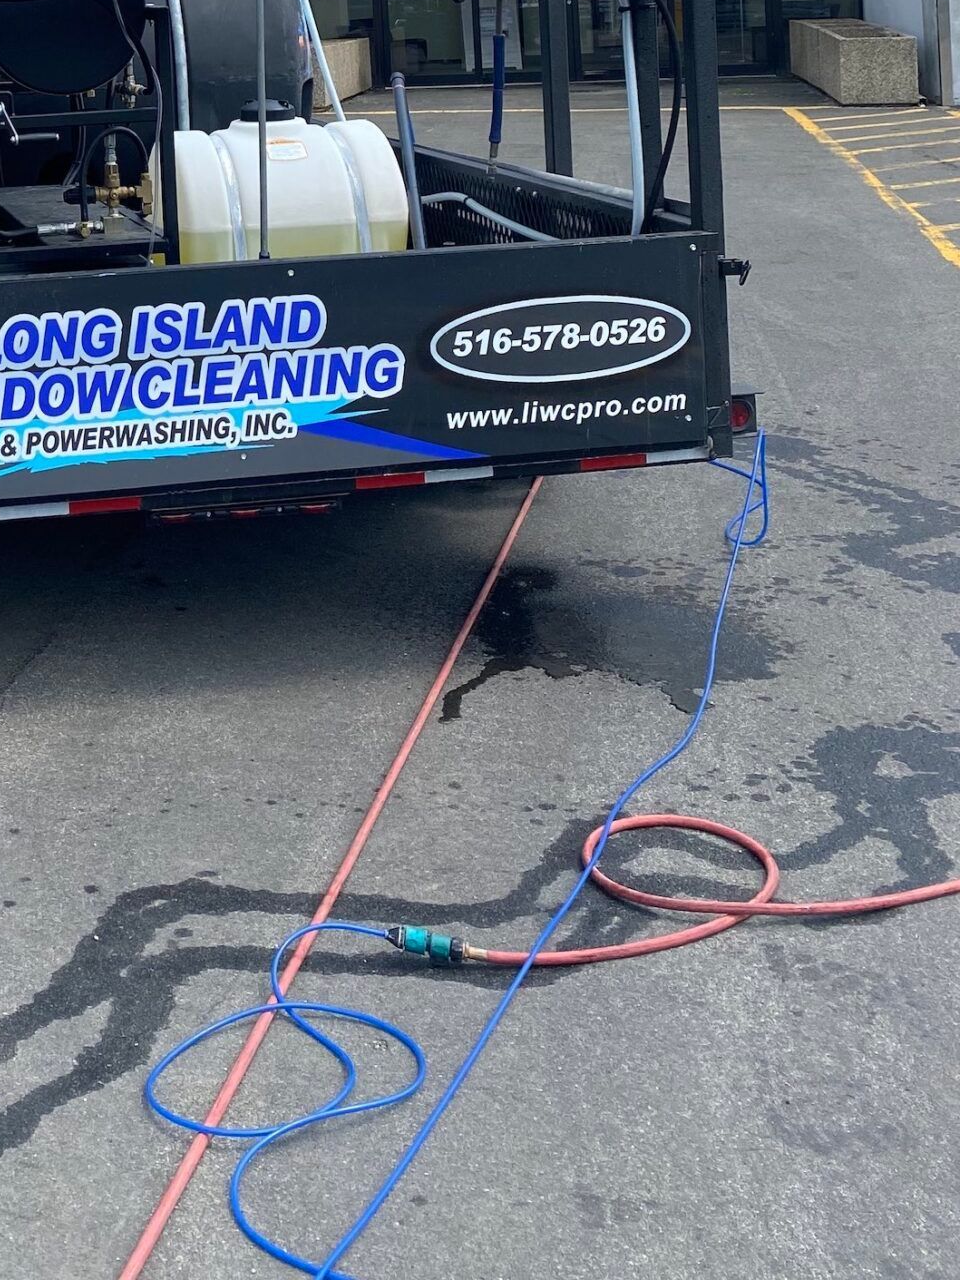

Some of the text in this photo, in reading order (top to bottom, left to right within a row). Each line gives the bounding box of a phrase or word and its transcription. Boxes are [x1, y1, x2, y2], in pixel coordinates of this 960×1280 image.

[132, 297, 324, 358] ISLAND
[452, 315, 667, 359] 516-578-0526
[135, 347, 402, 411] CLEANING
[0, 410, 294, 457] & POWERWASHING, INC.
[446, 394, 688, 431] www.liwcpro.com
